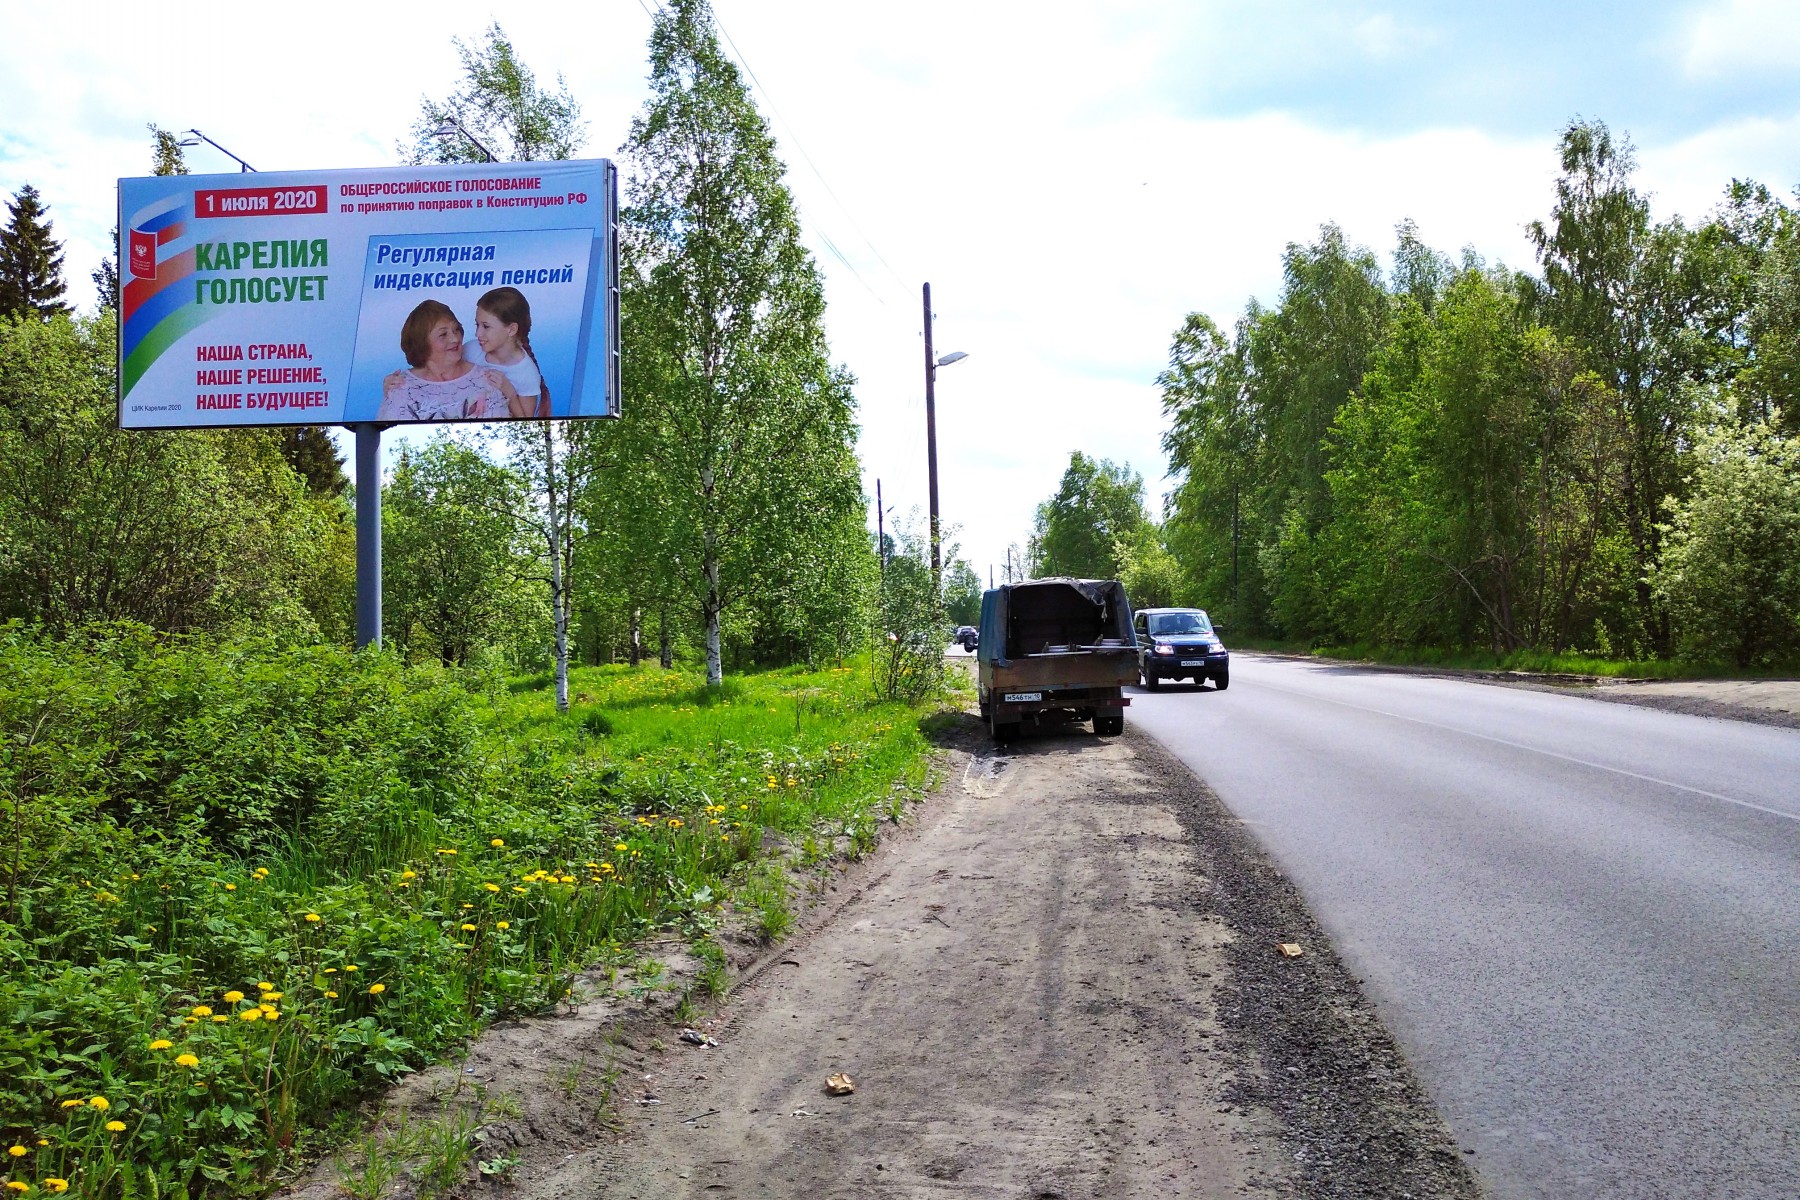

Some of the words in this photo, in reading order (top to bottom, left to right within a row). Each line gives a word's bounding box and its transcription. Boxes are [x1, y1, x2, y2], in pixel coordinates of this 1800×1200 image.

[340, 179, 452, 197] ОБЩЕРОССИЙСКОЕ
[455, 177, 541, 192] ГОЛОСОВАНИЕ
[206, 195, 214, 212] 1
[221, 196, 269, 211] июля
[273, 190, 317, 209] 2020
[340, 203, 354, 213] по
[357, 201, 415, 214] принятию
[418, 199, 473, 212] поправок
[476, 200, 483, 208] в
[486, 196, 564, 208] Конституцию
[567, 192, 588, 205] РФ
[196, 239, 328, 271] КАРЕЛИЯ
[377, 244, 496, 267] Регулярная
[373, 270, 495, 291] индексация
[501, 264, 574, 285] пенсий
[196, 275, 328, 305] ГОЛОСУЕТ
[196, 346, 243, 361] НАША
[248, 343, 313, 361] СТРАНА,
[196, 369, 243, 386] НАШЕ
[247, 367, 327, 385] РЕШЕНИЕ,
[196, 393, 243, 410] НАШЕ
[246, 391, 329, 411] БУДУЩЕЕ!
